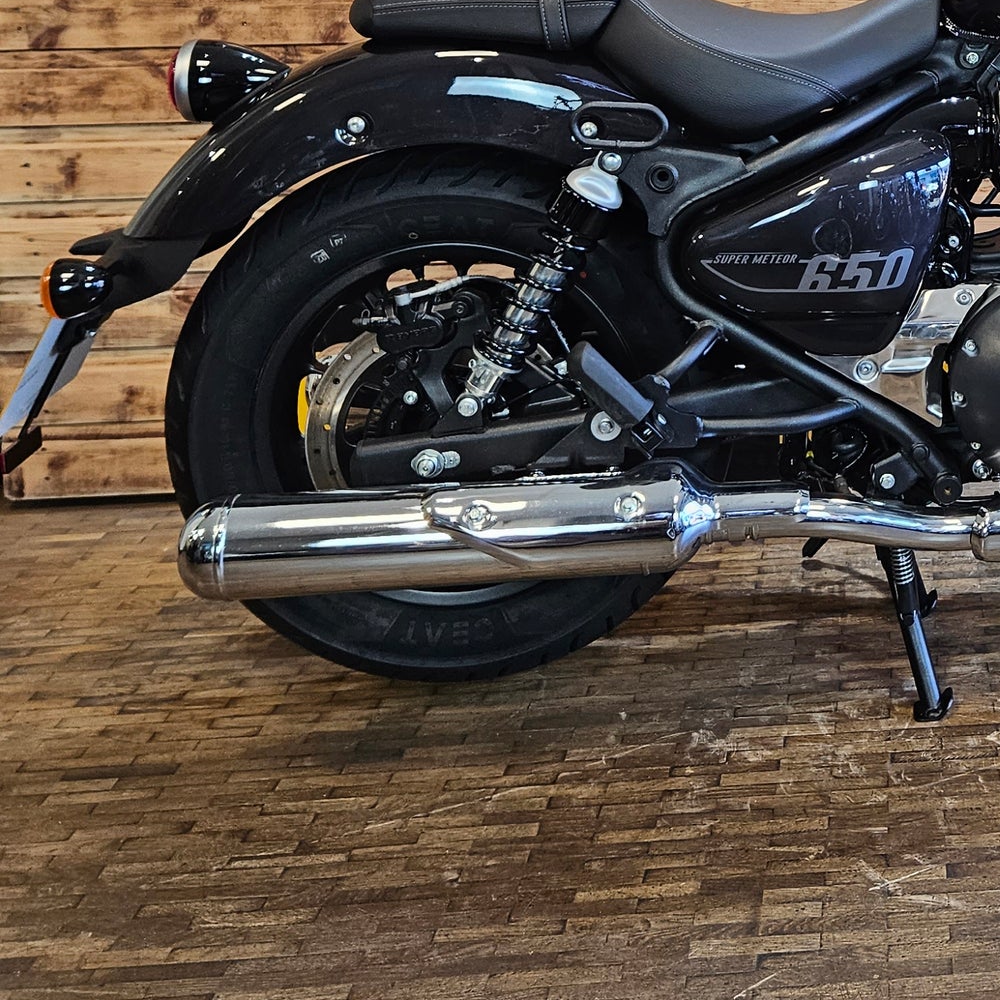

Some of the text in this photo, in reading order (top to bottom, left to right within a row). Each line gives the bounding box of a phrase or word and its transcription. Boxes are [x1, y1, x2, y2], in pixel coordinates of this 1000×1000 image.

[713, 253, 799, 265] SUPER METEOR
[798, 246, 915, 292] 650
